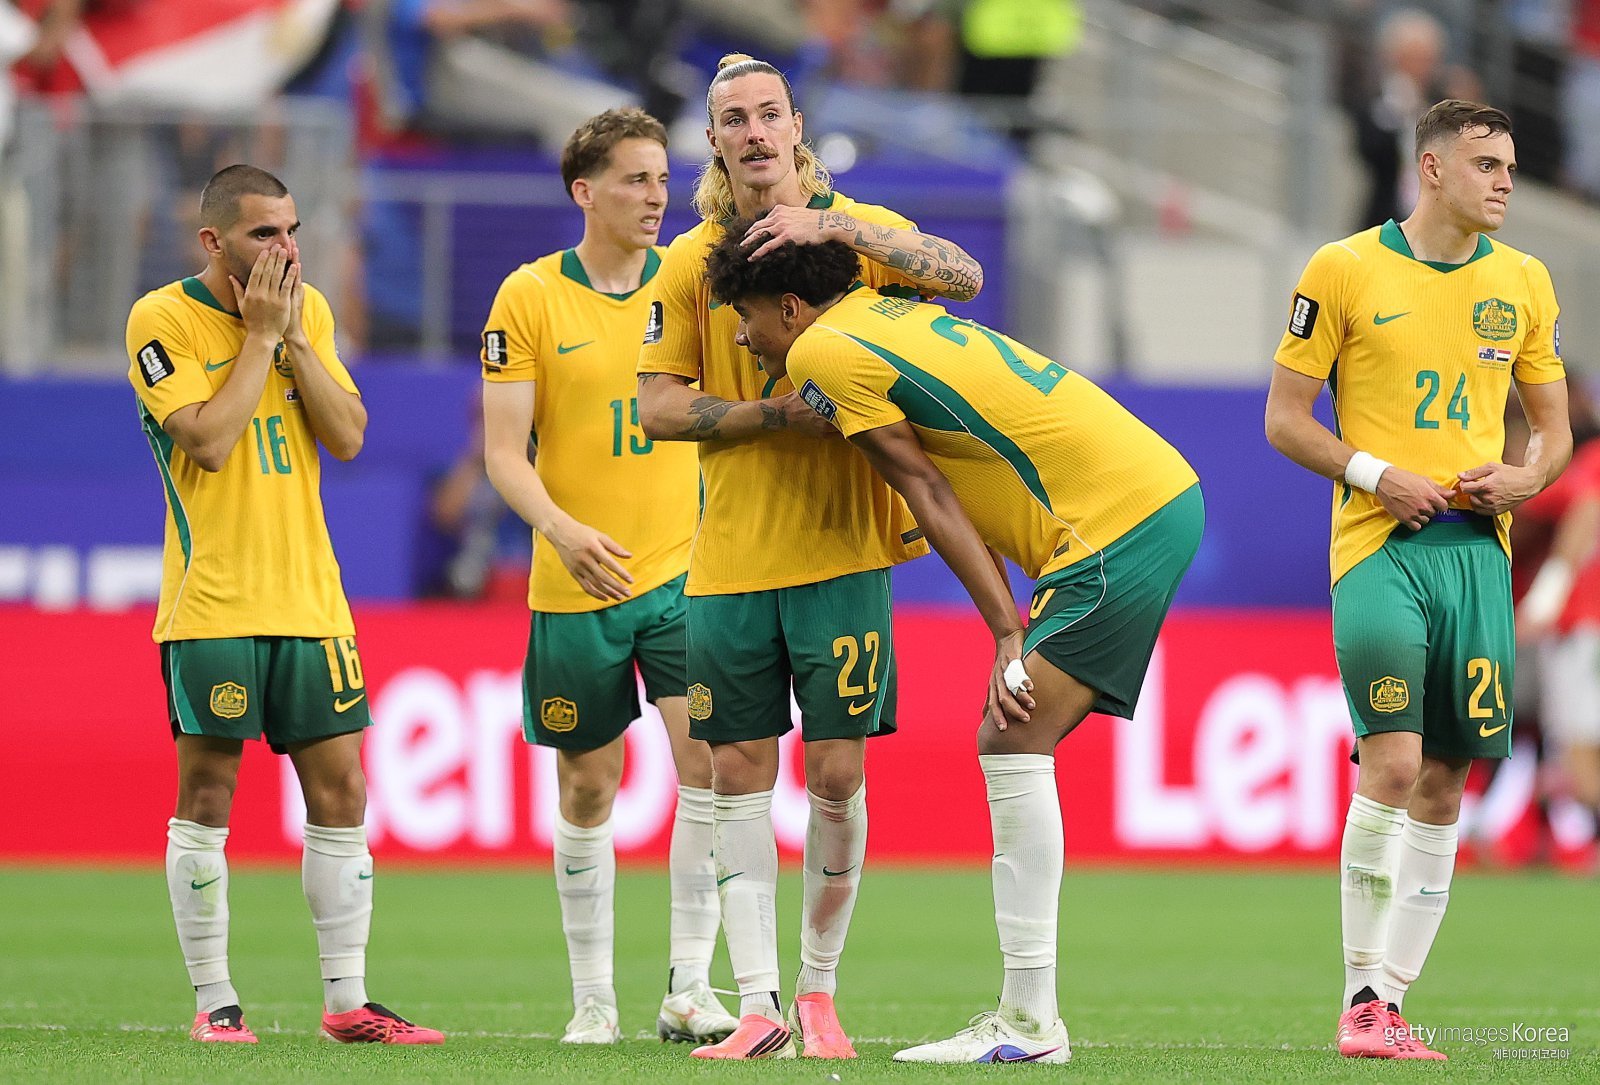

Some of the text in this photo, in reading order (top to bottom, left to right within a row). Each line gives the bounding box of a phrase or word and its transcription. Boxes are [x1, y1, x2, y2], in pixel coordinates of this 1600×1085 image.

[609, 397, 654, 457] 15
[1414, 370, 1470, 431] 24
[252, 415, 292, 474] 16
[320, 635, 364, 694] 16
[832, 631, 880, 698] 22
